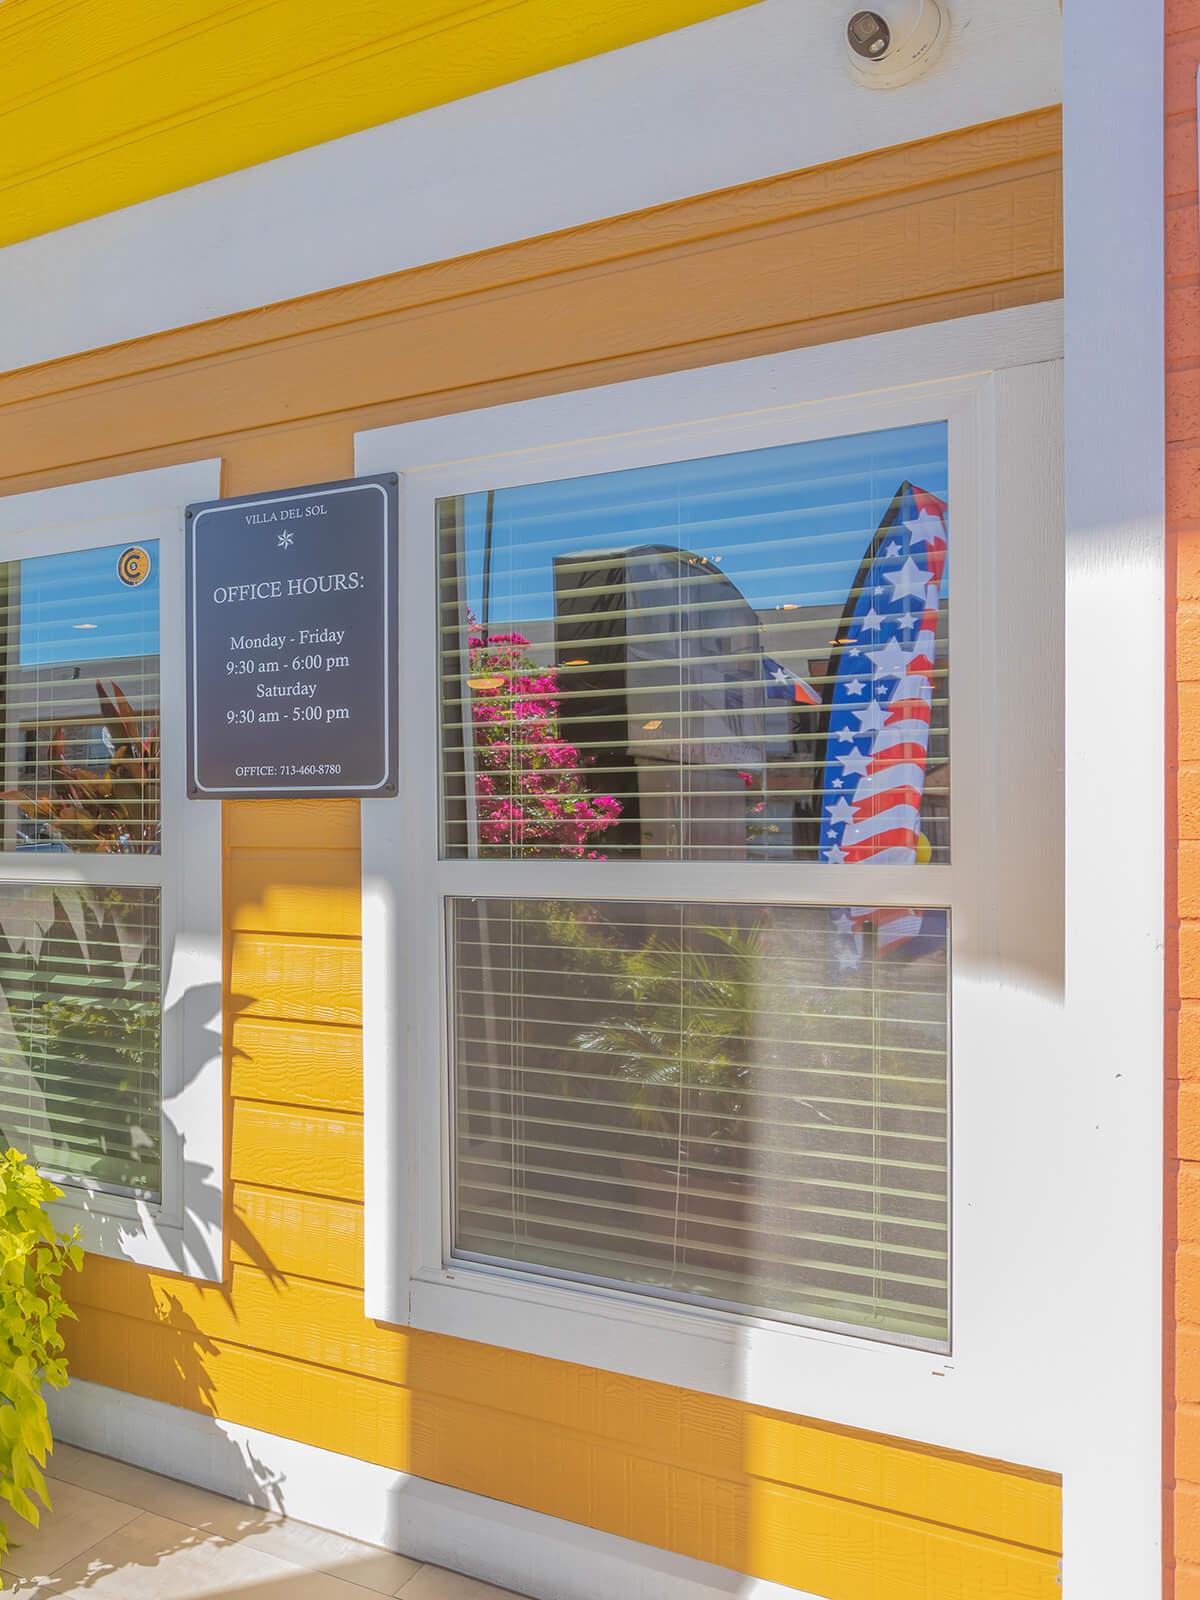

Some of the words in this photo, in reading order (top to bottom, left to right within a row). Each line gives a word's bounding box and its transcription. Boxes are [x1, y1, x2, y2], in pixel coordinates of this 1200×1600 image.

[245, 512, 278, 525] VILLA
[280, 508, 303, 521] DEL
[305, 505, 328, 517] SOL
[213, 581, 282, 604] OFFICE
[287, 571, 365, 596] HOURS:
[230, 633, 286, 650] Monday
[299, 628, 345, 644] Friday
[226, 659, 255, 675] 9:30
[258, 661, 280, 673] am
[292, 654, 322, 670] 6:00
[326, 655, 350, 671] pm
[256, 682, 317, 698] Saturday
[226, 709, 255, 724] 9:30
[258, 711, 280, 723] am
[292, 705, 322, 721] 5:00
[326, 707, 350, 723] pm
[235, 766, 277, 776] OFFICE:
[280, 764, 341, 775] 713-460-8780
